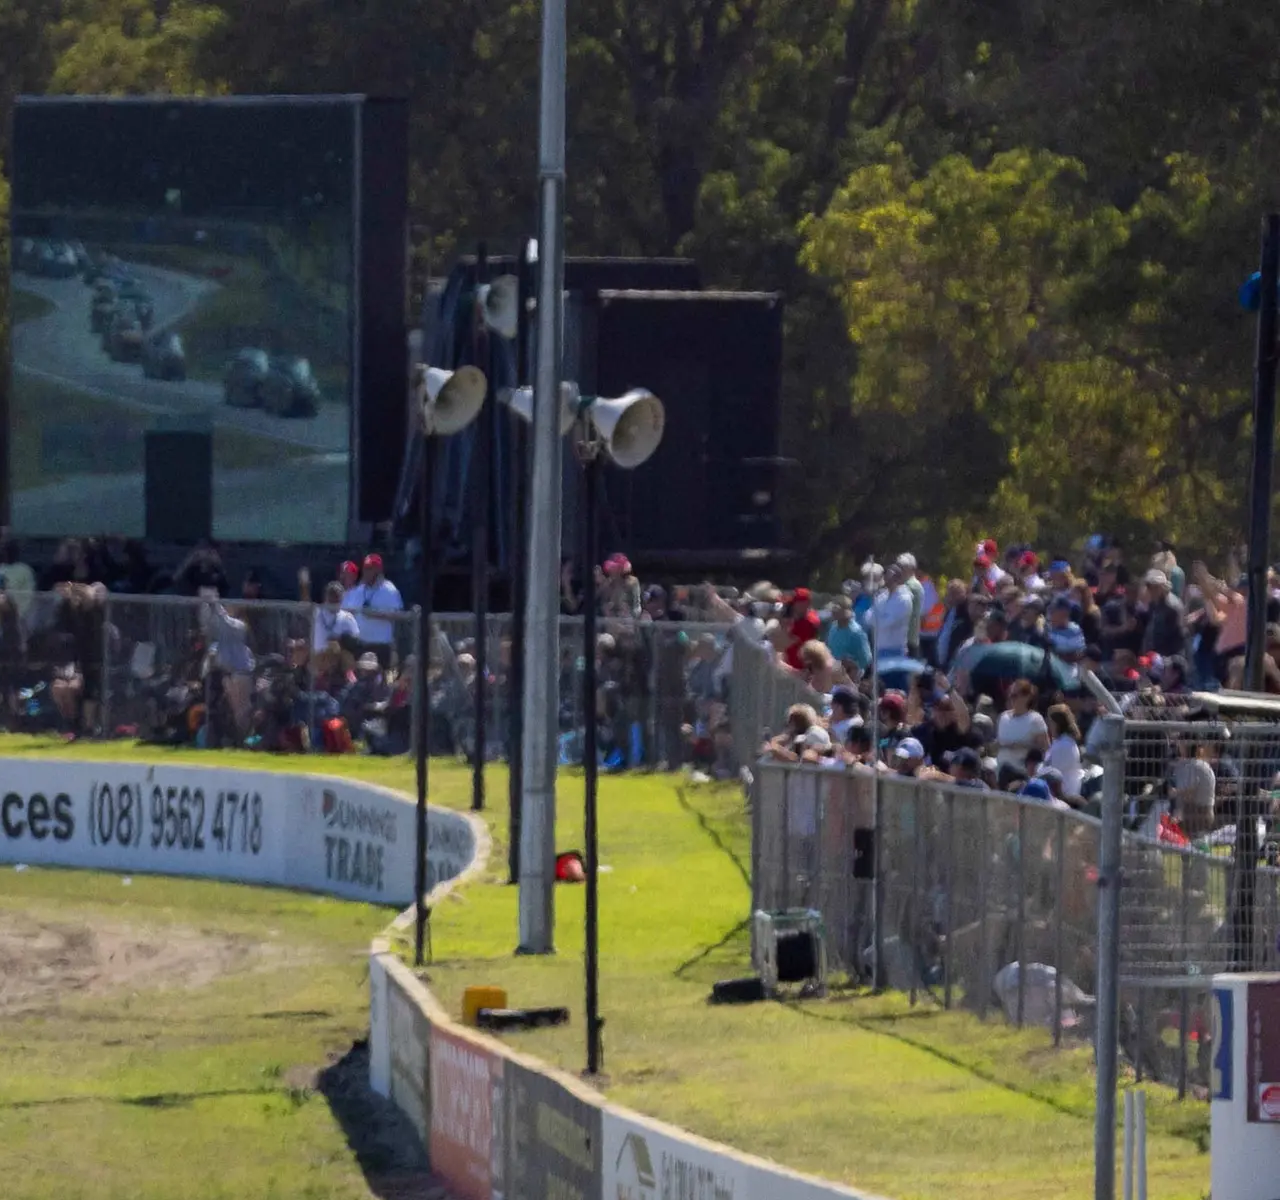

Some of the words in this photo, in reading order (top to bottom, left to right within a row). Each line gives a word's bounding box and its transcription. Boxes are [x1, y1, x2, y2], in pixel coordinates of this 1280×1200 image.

[90, 780, 142, 847] (08)
[149, 785, 205, 851] 9562
[212, 790, 263, 857] 4718
